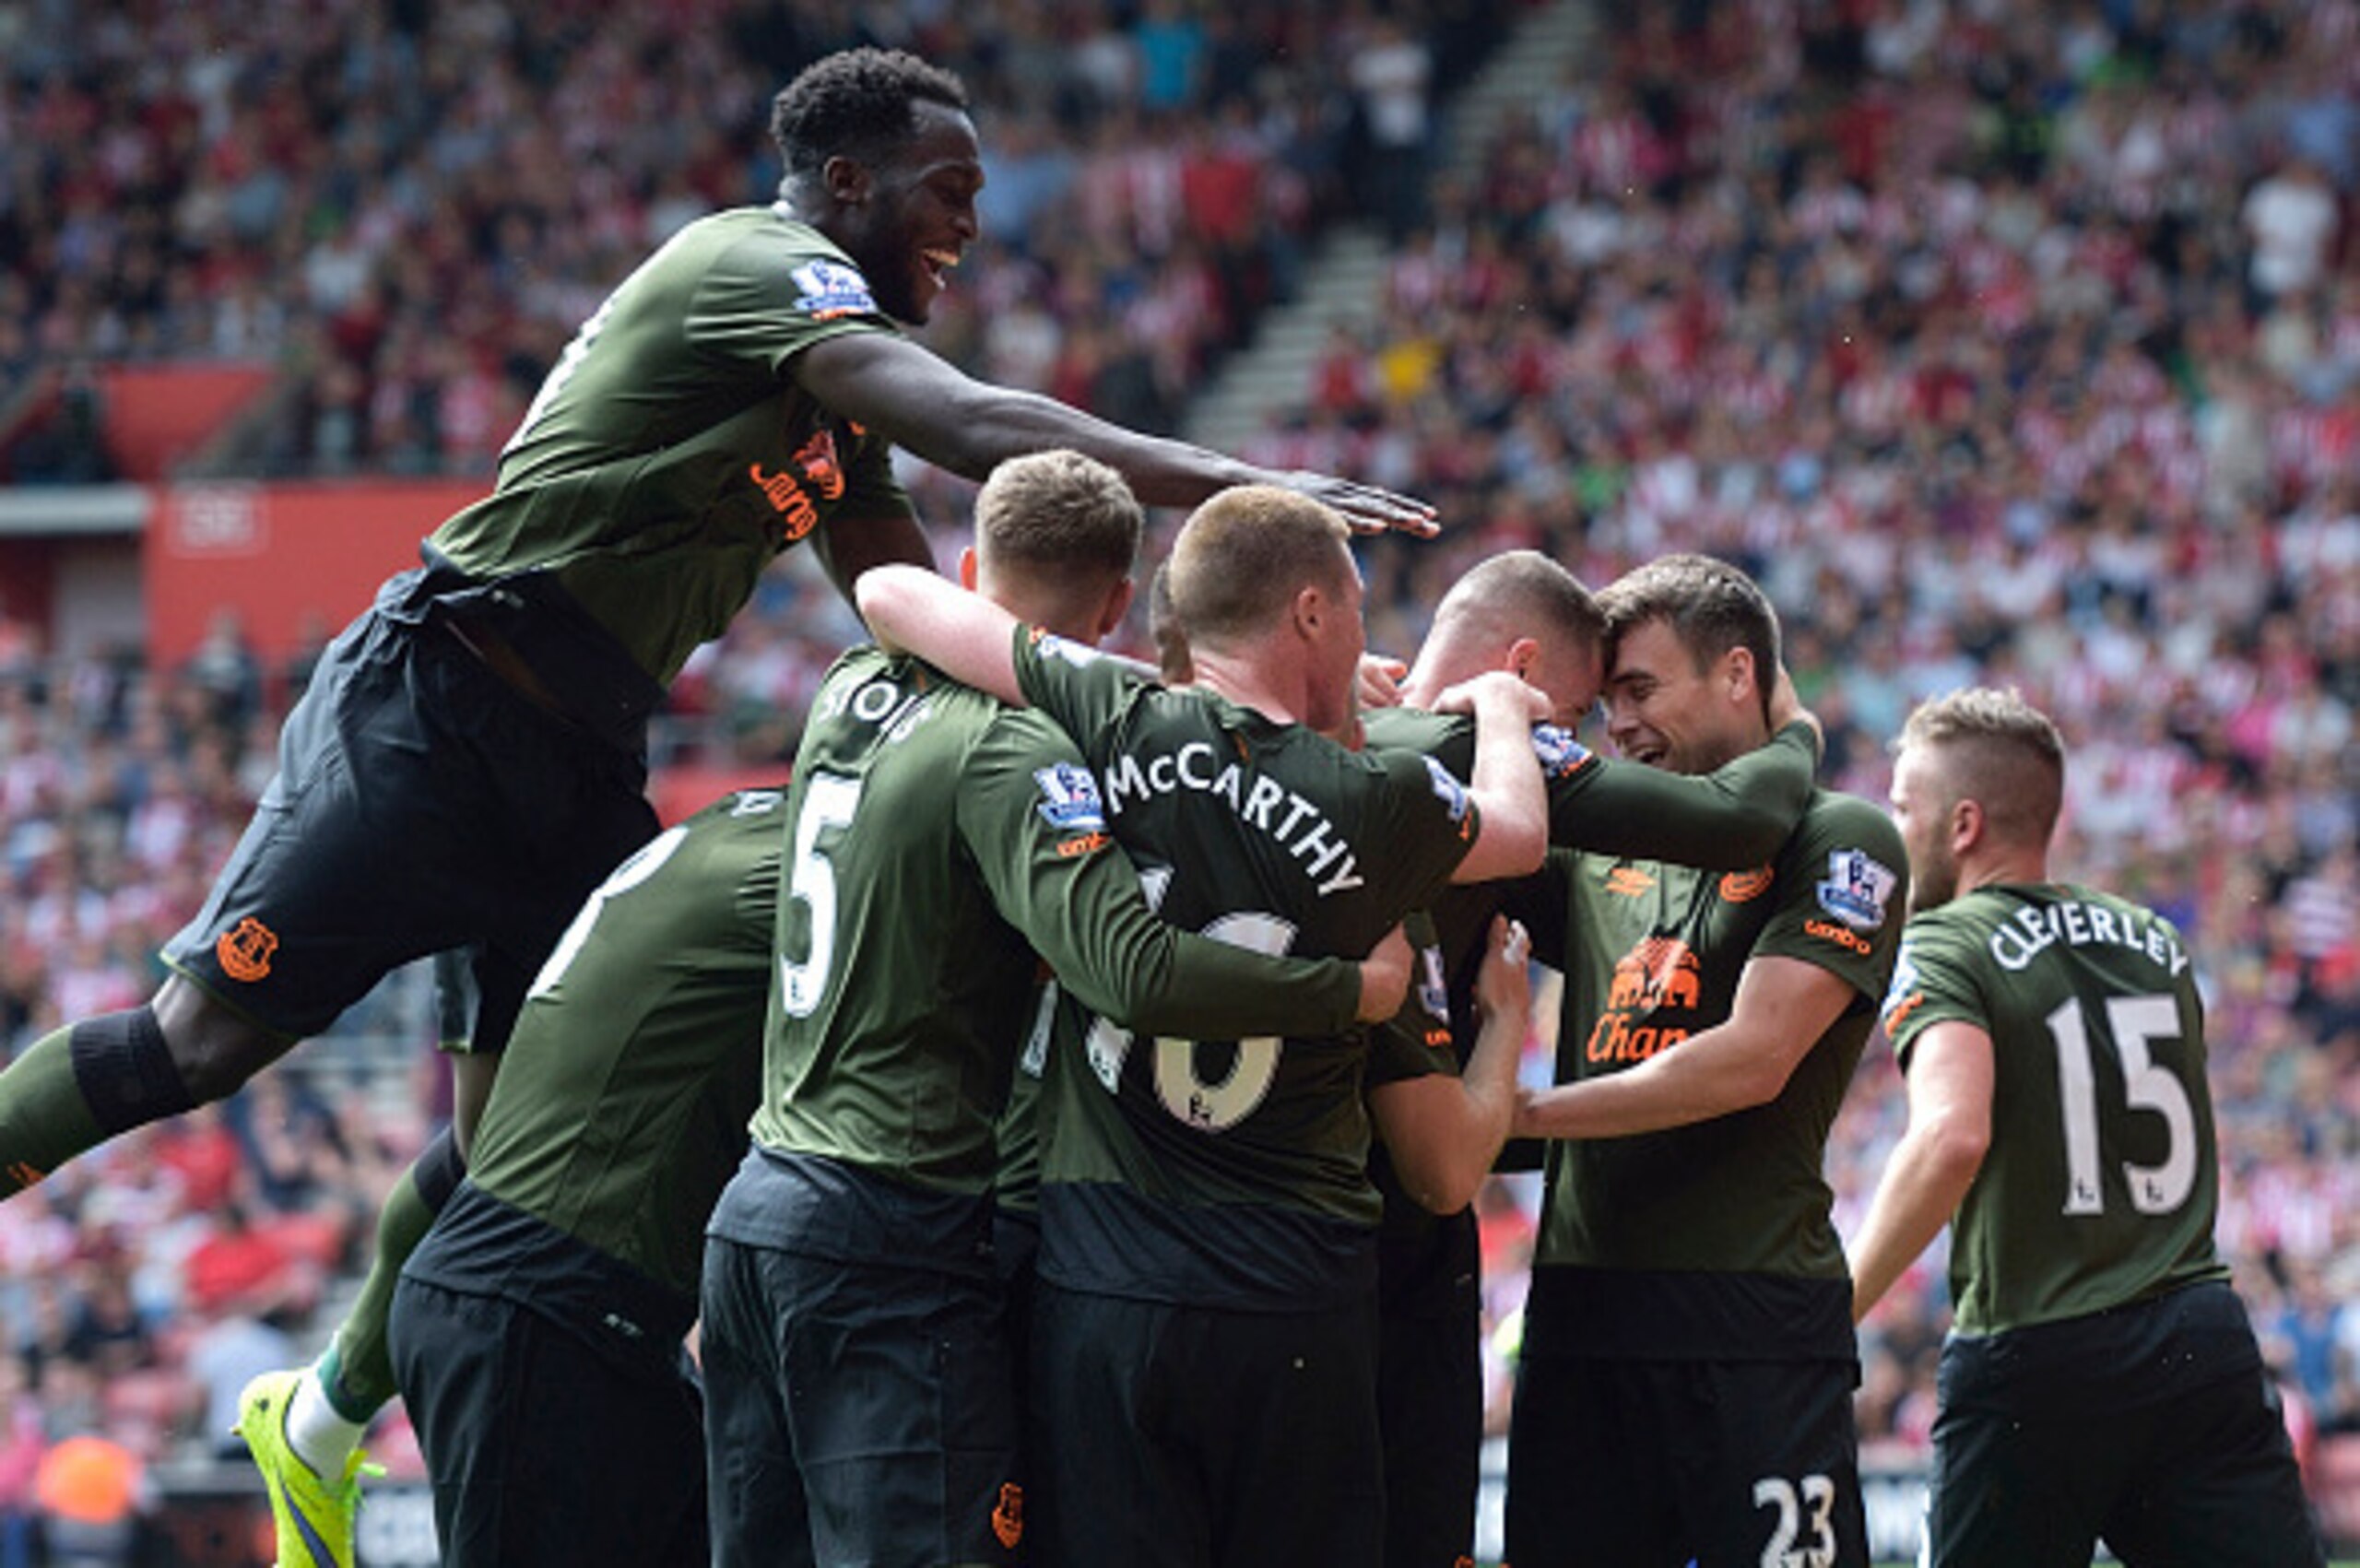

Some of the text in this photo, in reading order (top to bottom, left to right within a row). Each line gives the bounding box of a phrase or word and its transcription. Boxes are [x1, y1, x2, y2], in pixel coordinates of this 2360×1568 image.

[781, 771, 863, 1018] 5
[1105, 743, 1363, 895] McCARTHY
[1587, 1012, 1690, 1062] Chan
[2046, 996, 2197, 1216] 15
[1753, 1475, 1835, 1568] 23
